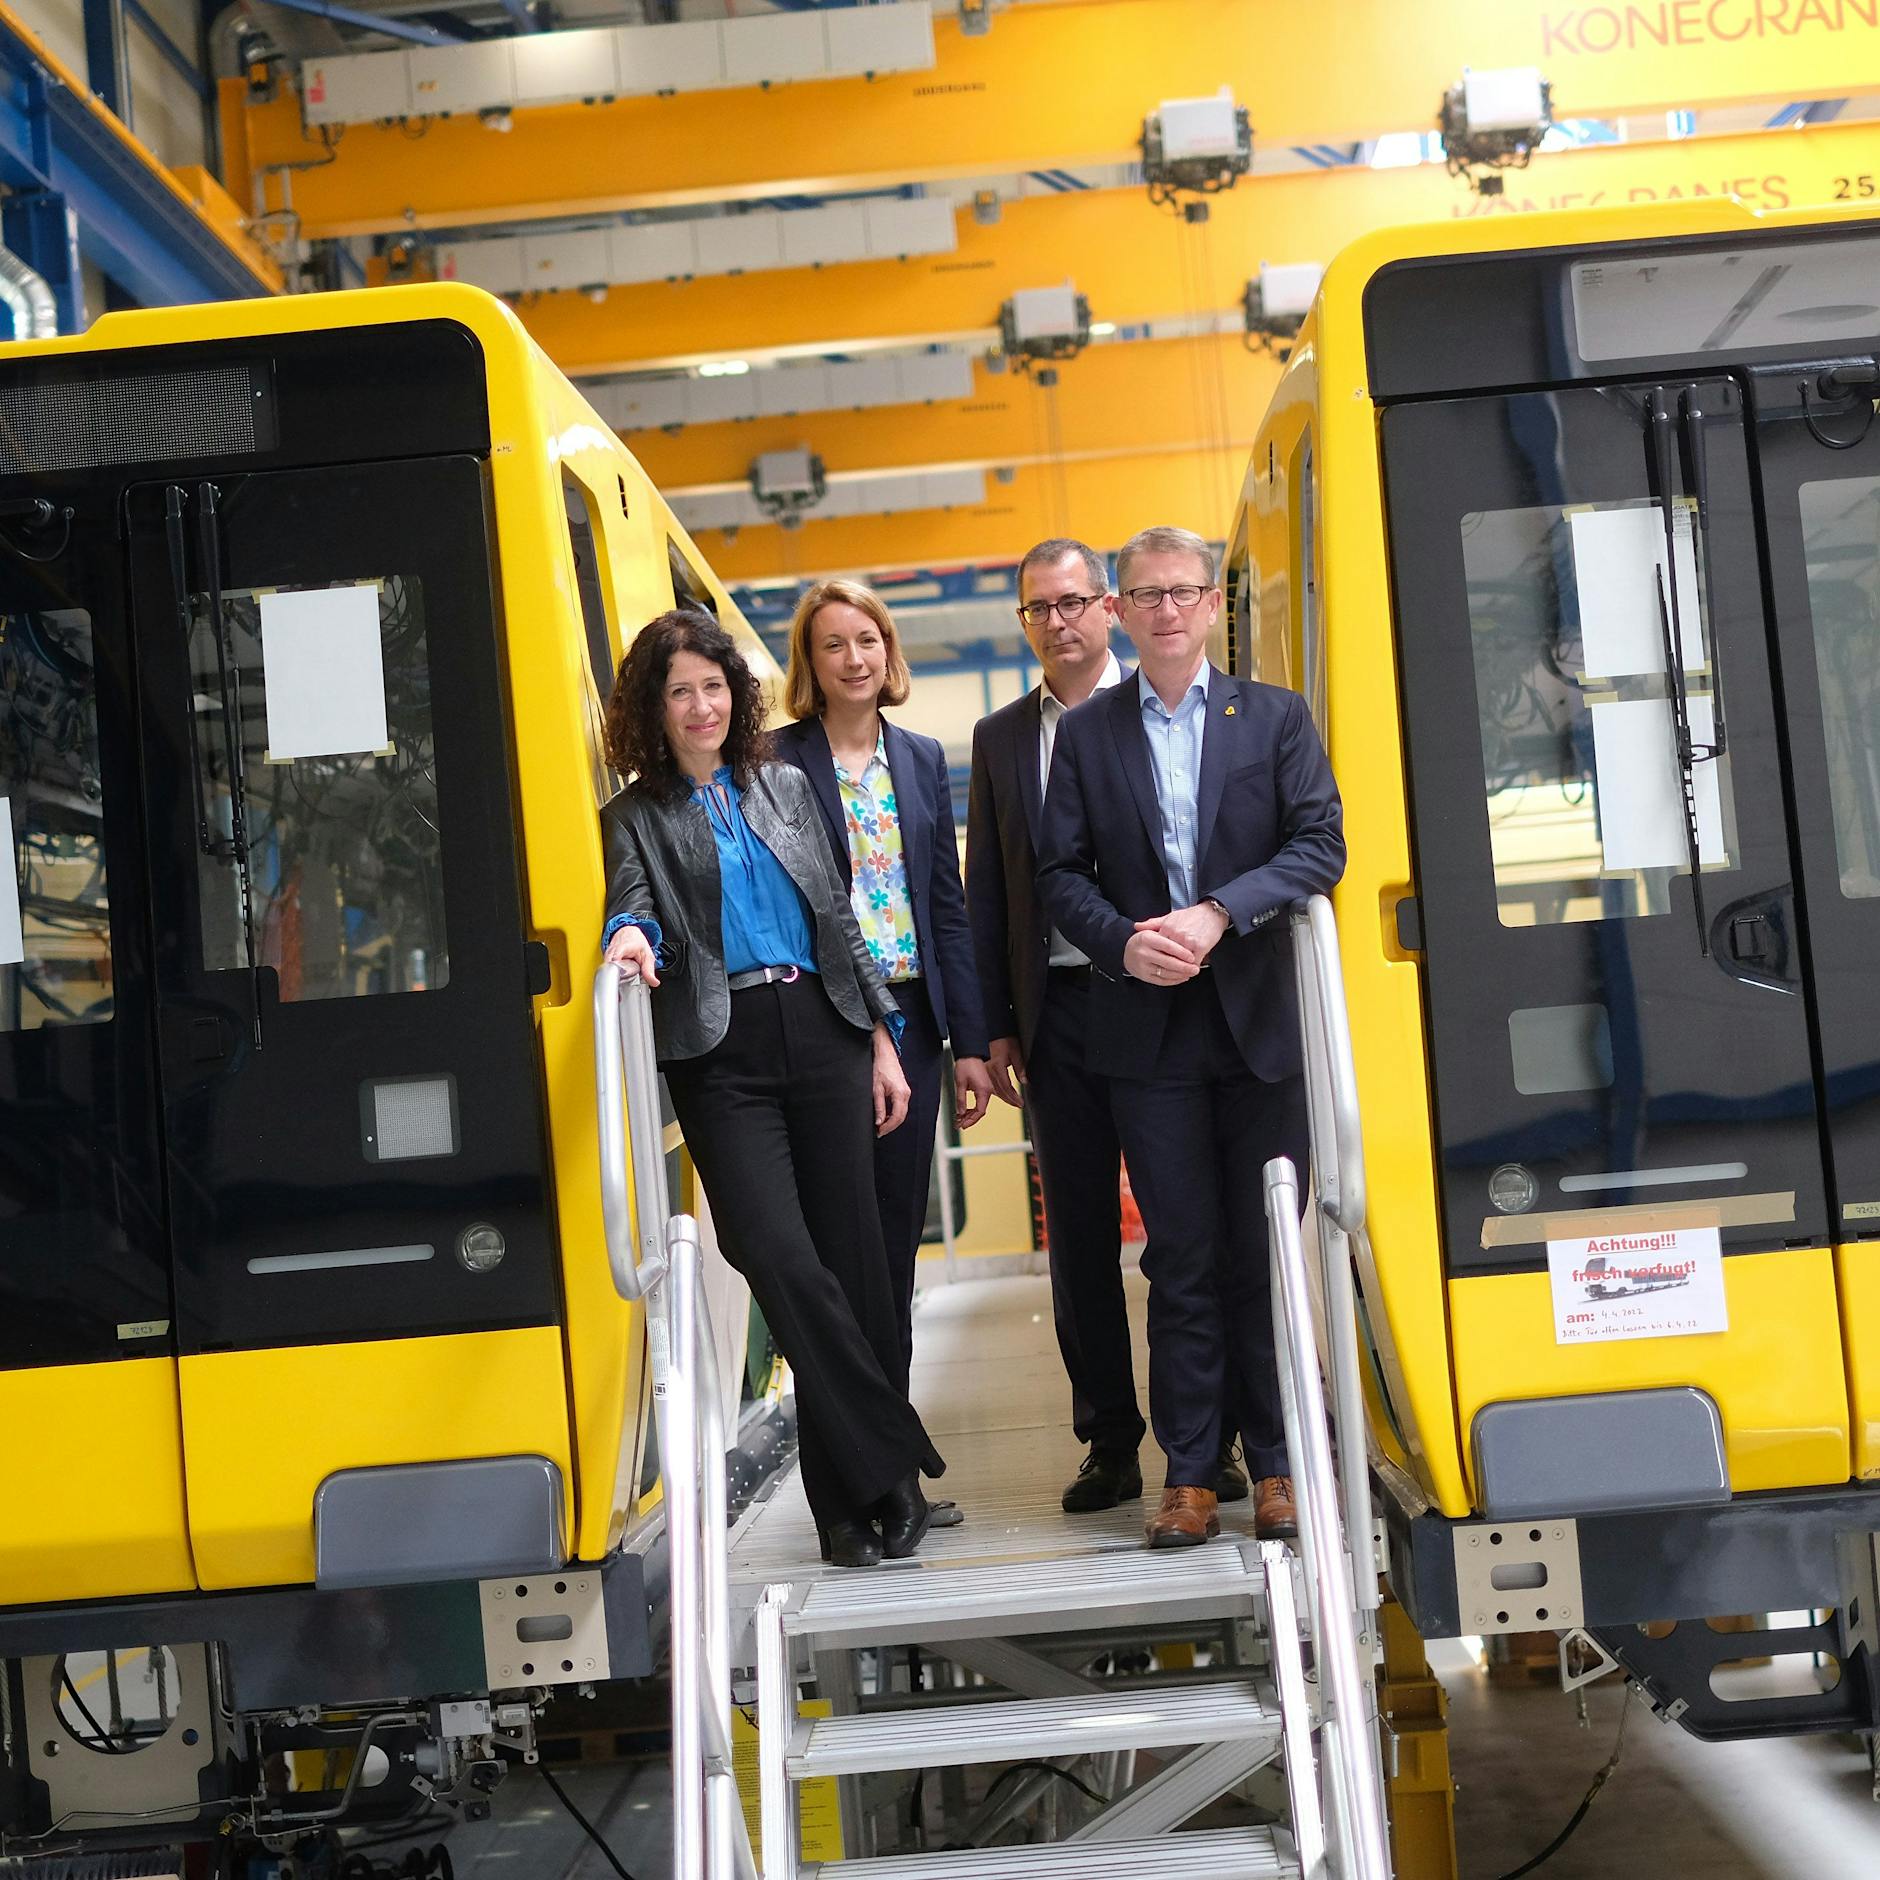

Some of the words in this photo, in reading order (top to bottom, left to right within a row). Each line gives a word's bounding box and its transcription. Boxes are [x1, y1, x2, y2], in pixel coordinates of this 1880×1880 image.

[1587, 1233, 1676, 1252] Achtung!!!
[1572, 1265, 1622, 1282] frisch
[1566, 1312, 1596, 1324] am:
